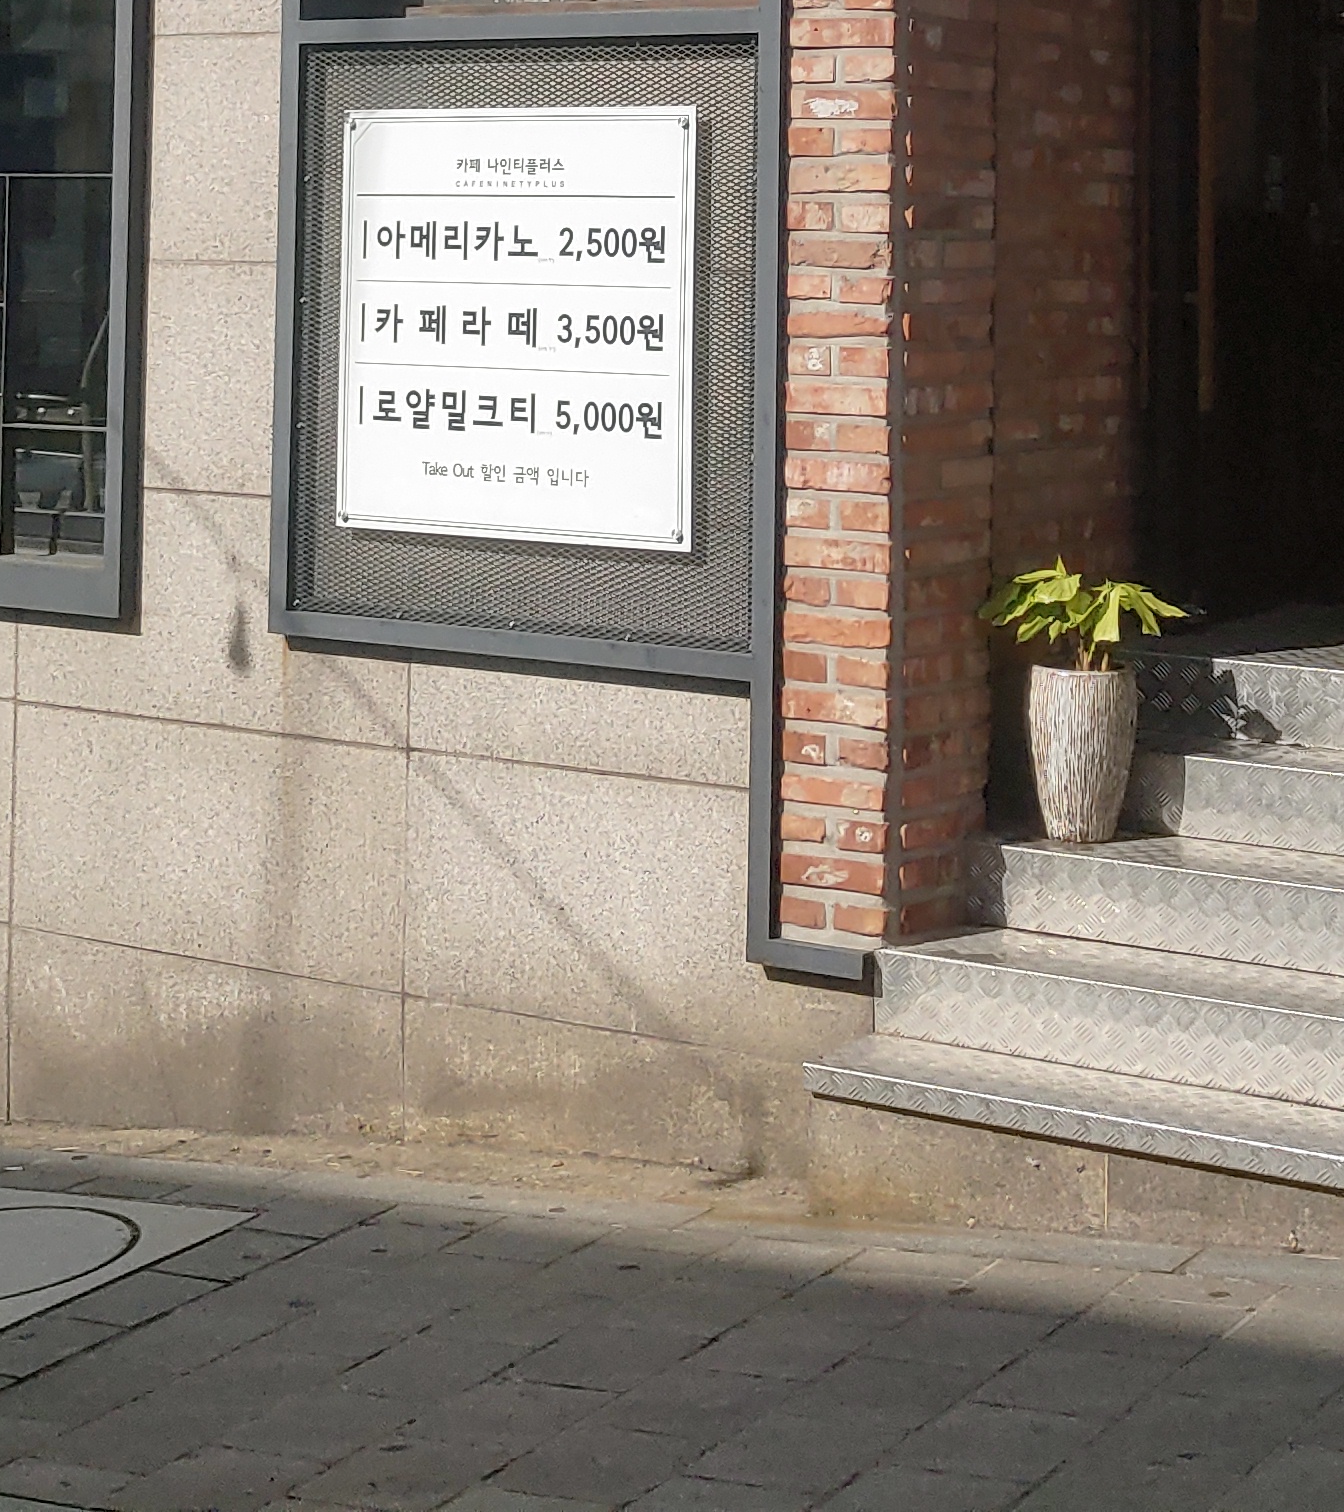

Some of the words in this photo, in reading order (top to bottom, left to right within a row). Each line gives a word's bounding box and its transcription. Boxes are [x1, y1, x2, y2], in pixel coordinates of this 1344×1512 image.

[456, 157, 481, 173] 카페
[487, 157, 565, 176] 나인티플러스
[377, 221, 539, 261] 아메리카노
[558, 225, 667, 265] 2,500원
[557, 312, 665, 352] 3,500원
[372, 388, 537, 434] 로얄밀크티
[555, 401, 664, 440] 5,000원
[422, 461, 448, 477] Take
[453, 463, 475, 478] Out
[481, 464, 506, 482] 할인
[513, 466, 540, 486] 금액
[547, 467, 590, 488] 입니다
